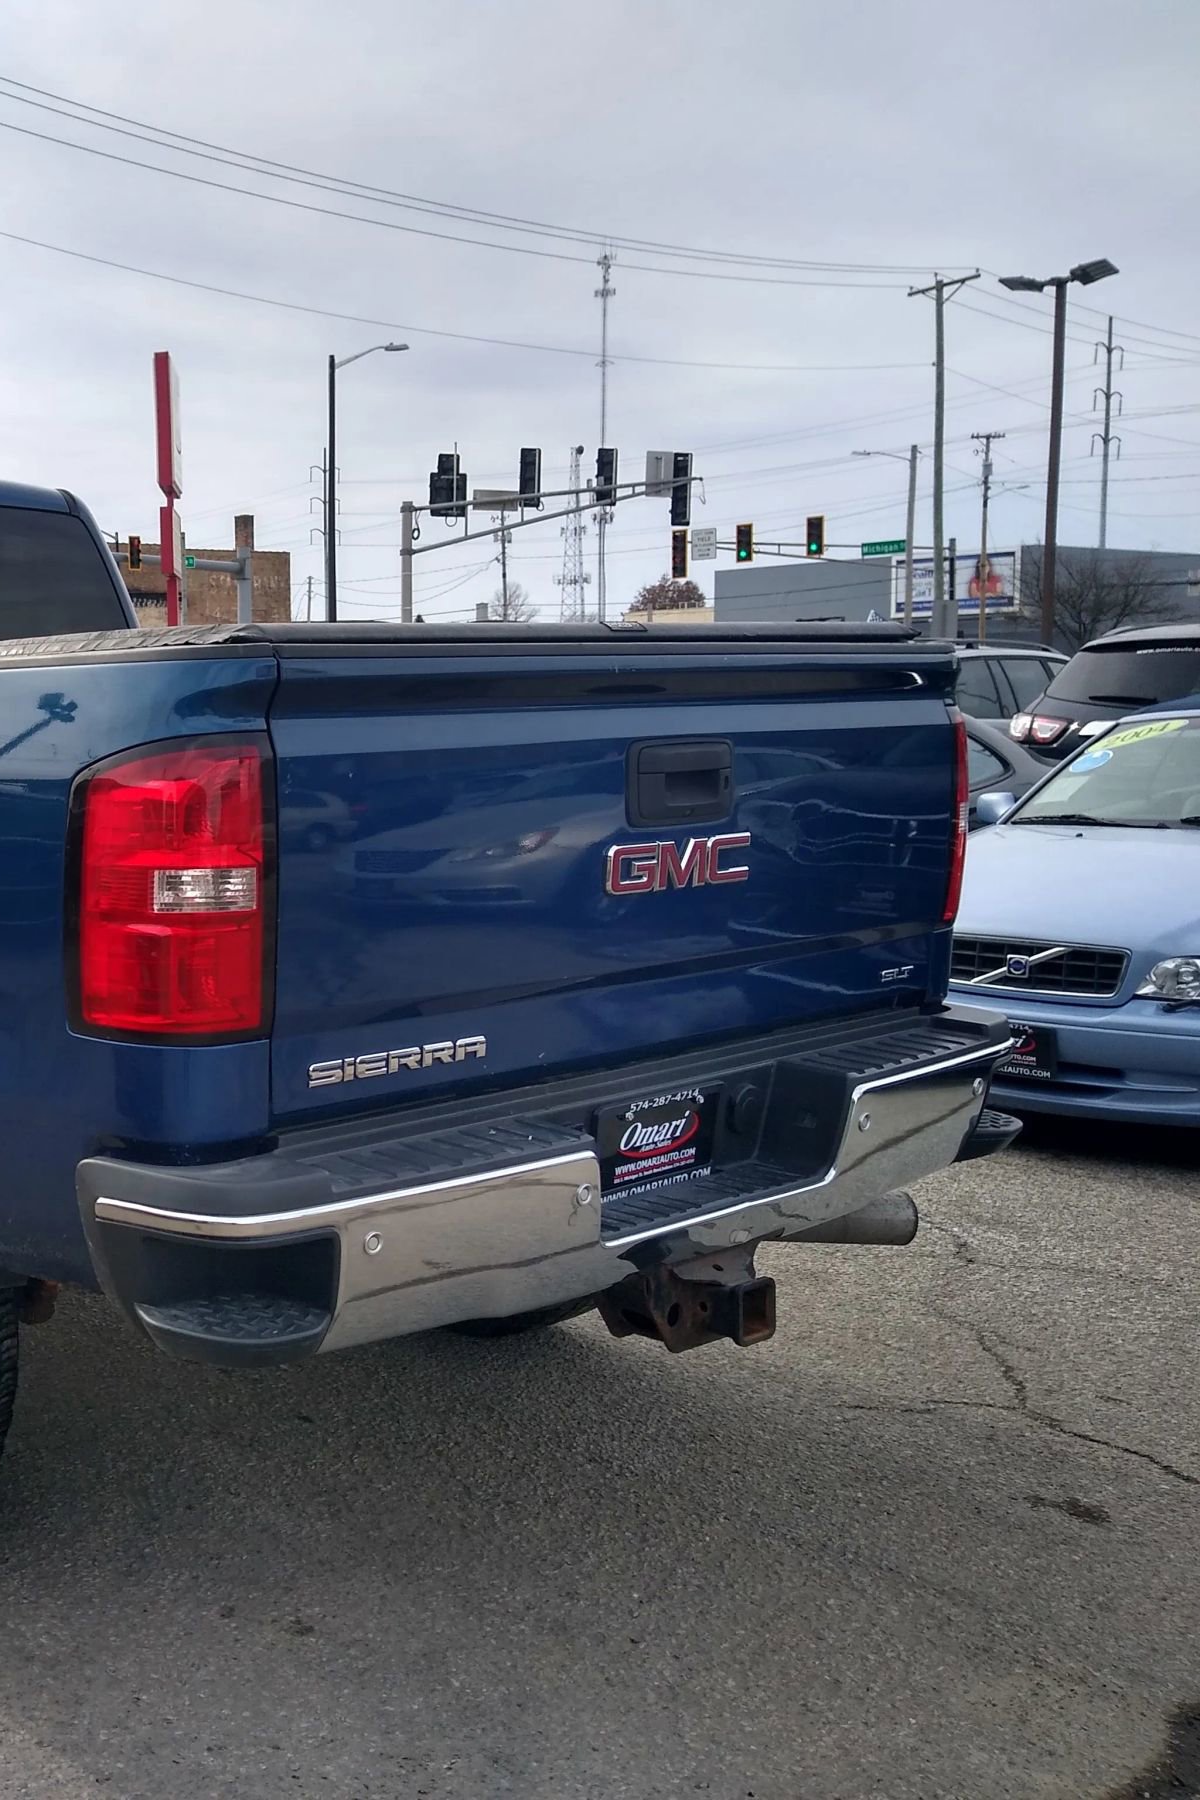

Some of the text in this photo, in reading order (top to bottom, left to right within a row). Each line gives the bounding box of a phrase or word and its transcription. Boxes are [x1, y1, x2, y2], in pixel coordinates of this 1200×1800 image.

[863, 544, 899, 554] Michigan
[1103, 723, 1170, 748] 2004
[605, 831, 751, 896] GMC
[881, 965, 914, 983] SLT
[308, 1035, 488, 1089] SIERRA
[629, 1088, 700, 1114] 574-287-4714
[620, 1110, 691, 1151] Omari
[614, 1147, 697, 1176] WWW.OMARIAUTO.COM
